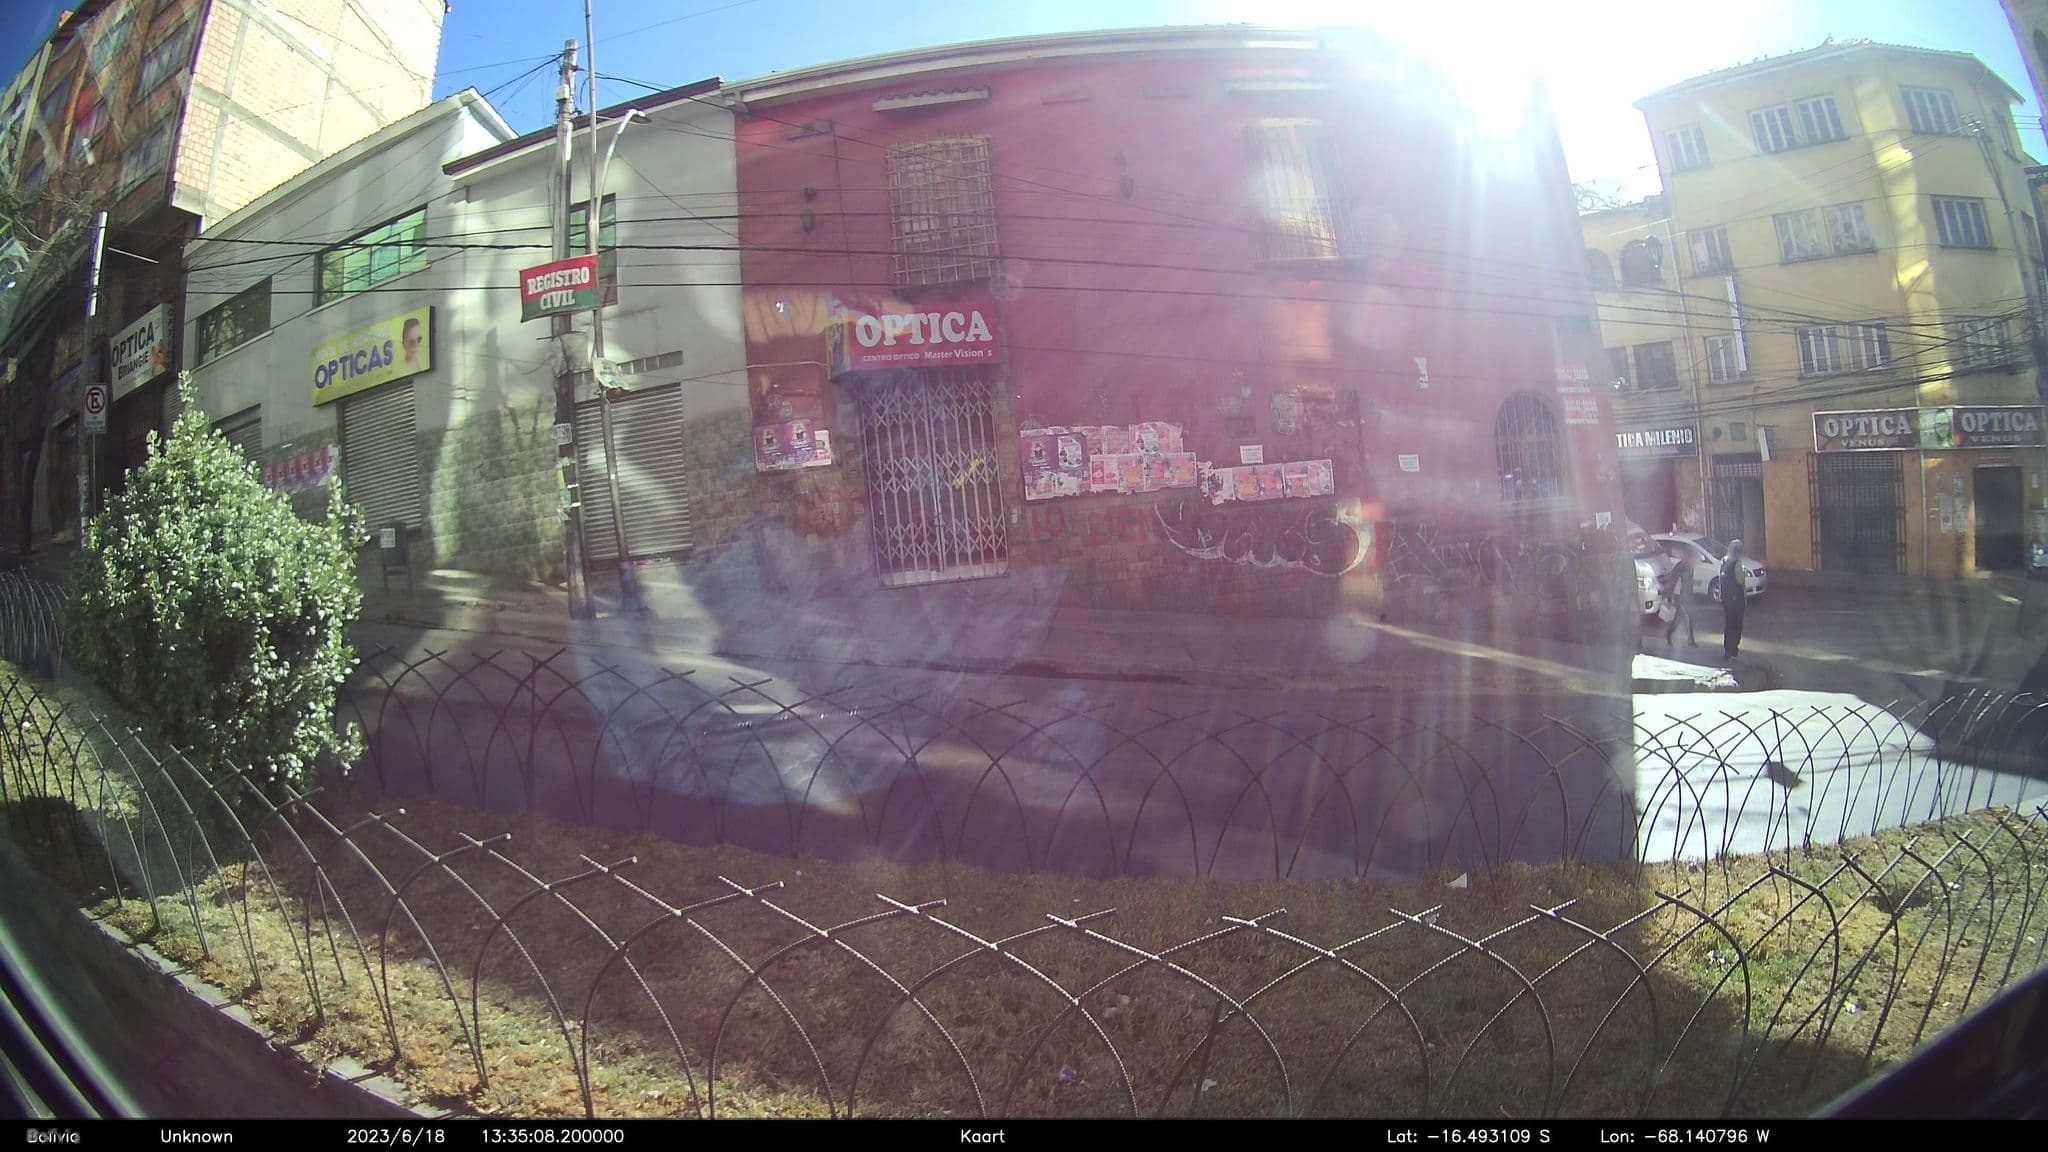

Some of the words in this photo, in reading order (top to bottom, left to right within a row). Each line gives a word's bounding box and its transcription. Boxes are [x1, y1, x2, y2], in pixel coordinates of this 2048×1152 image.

[527, 266, 590, 295] REGISTRO
[540, 289, 576, 310] CIVIL
[856, 311, 993, 347] OPTICA
[111, 321, 155, 368] OPTICA
[924, 351, 953, 360] Master
[315, 340, 393, 389] OPTICAS
[1824, 415, 1912, 438] OPTICA
[1961, 411, 2039, 433] OPTICA
[1644, 428, 1693, 447] MILENIO
[1841, 438, 1885, 447] VENUS
[1969, 434, 2023, 443] VENUS
